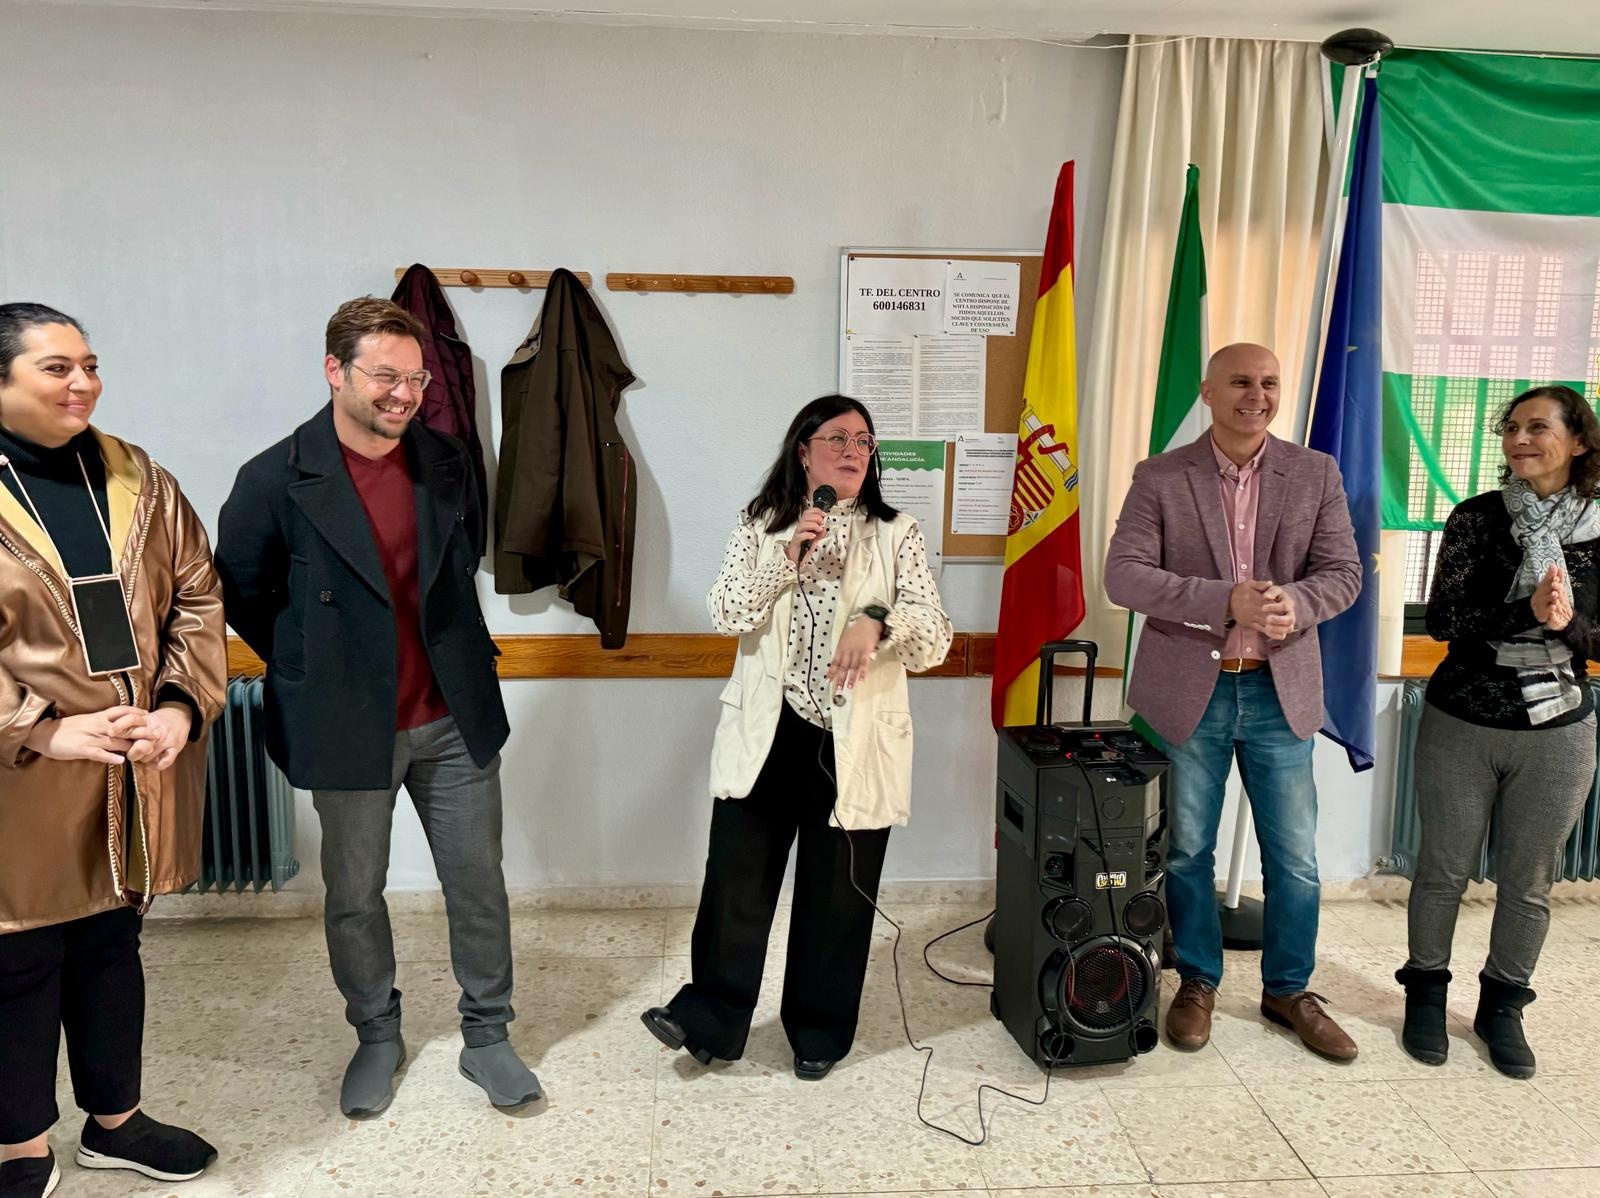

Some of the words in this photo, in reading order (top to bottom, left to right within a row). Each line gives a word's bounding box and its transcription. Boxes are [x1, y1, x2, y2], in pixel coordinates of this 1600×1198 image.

[859, 288, 874, 296] TF.
[876, 288, 896, 297] DEL
[898, 289, 940, 297] CENTRO
[873, 301, 925, 311] 600146831
